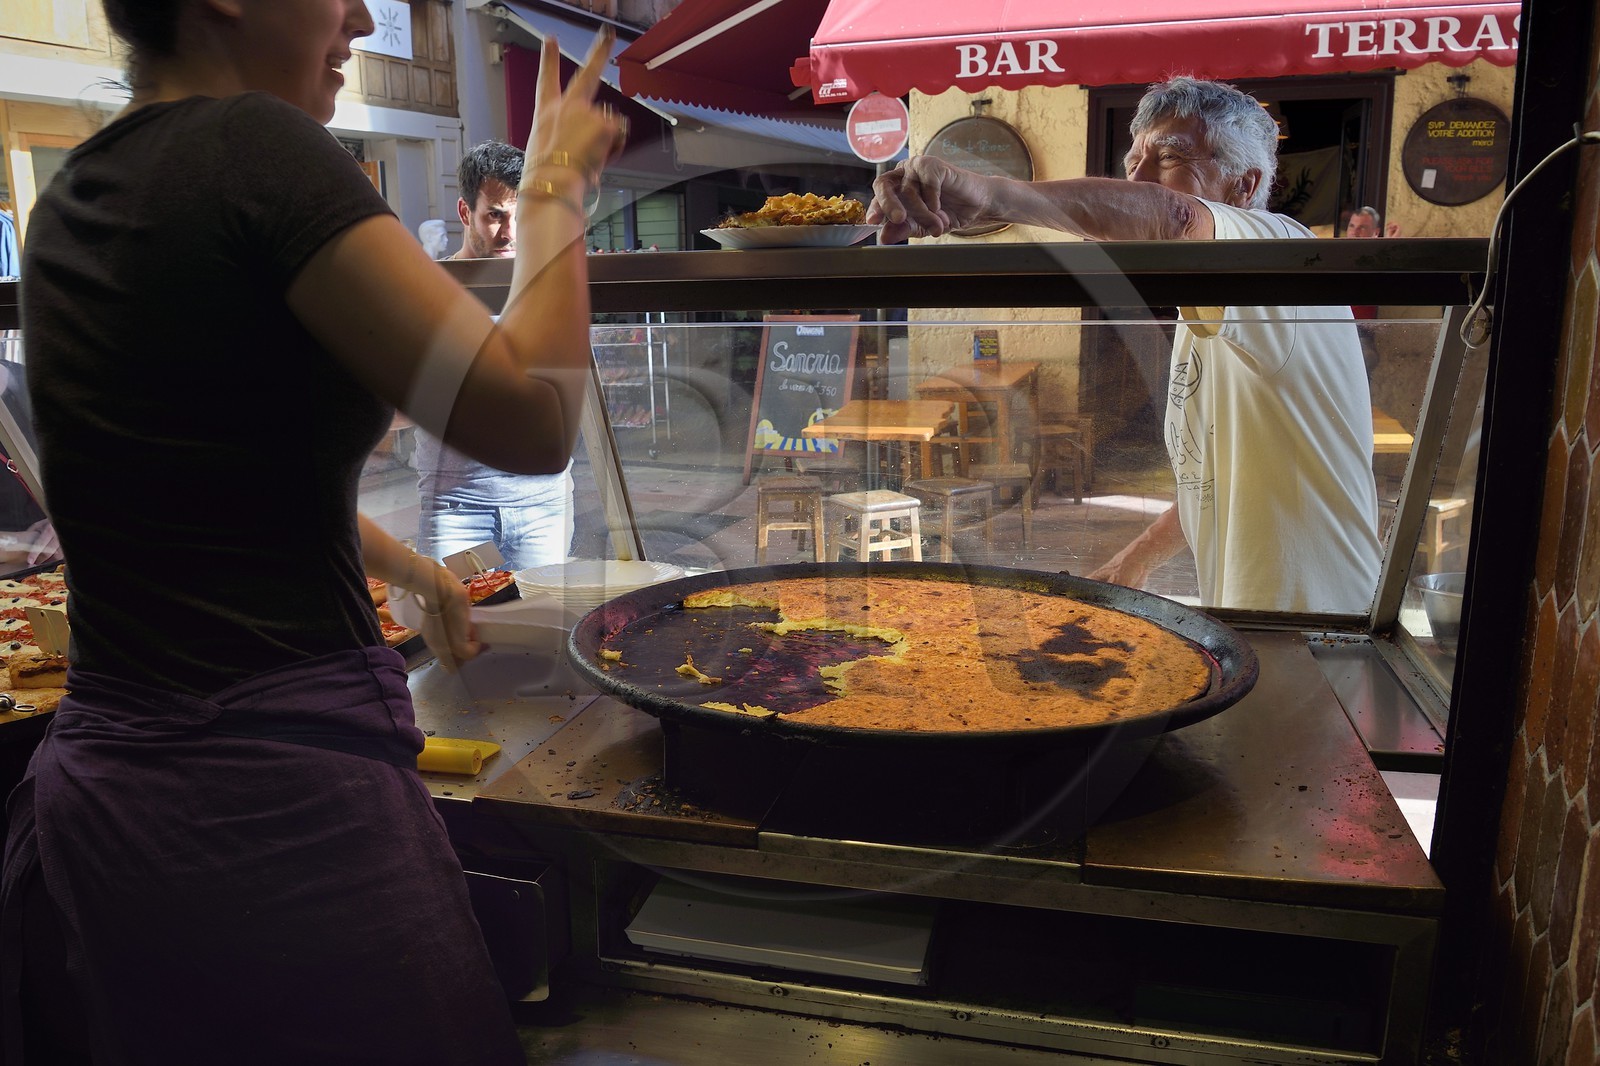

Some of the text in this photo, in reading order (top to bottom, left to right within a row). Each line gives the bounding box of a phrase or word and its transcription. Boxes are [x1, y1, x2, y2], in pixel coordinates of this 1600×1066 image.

[956, 39, 1066, 78] BAR
[1427, 120, 1496, 130] SVP DEMANDEZ
[1428, 129, 1495, 138] VOTRE ADDITION
[1472, 139, 1494, 147] merci
